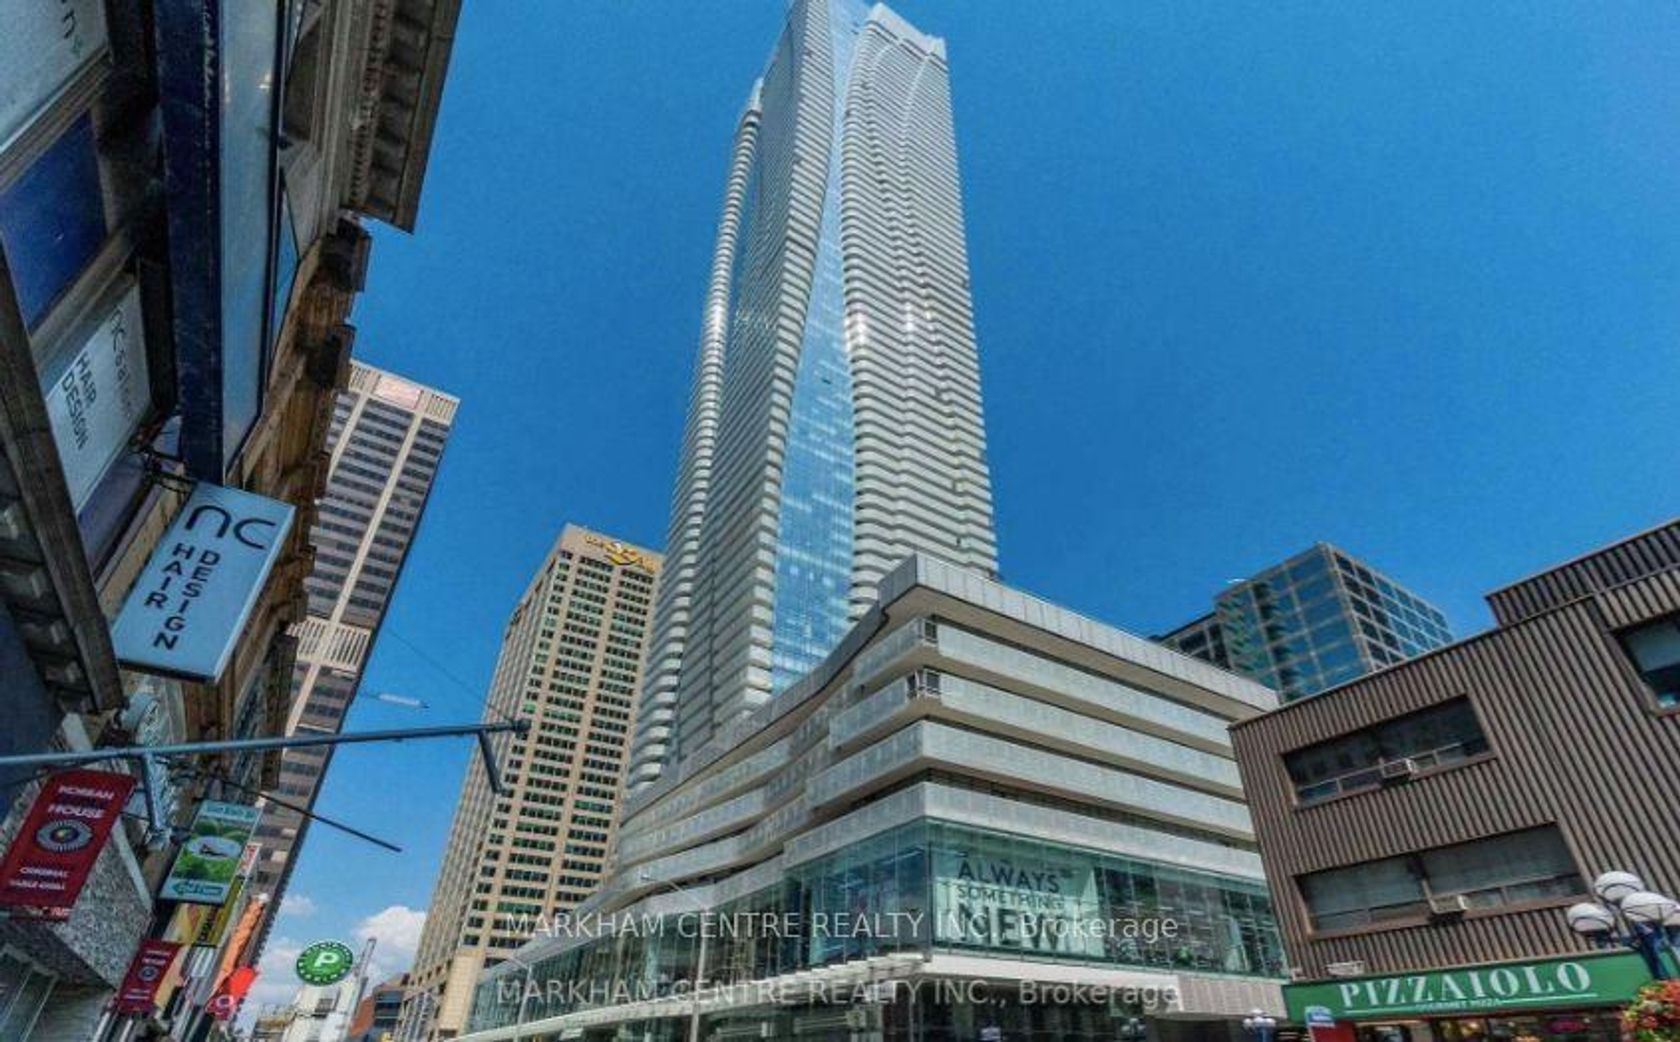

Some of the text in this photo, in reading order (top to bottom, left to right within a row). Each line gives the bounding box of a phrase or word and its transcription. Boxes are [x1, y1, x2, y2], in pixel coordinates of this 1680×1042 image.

[143, 542, 193, 611] HAIR
[153, 549, 220, 650] DESIGN
[47, 803, 105, 820] HOUSE
[957, 860, 1060, 894] ALWAYS
[1339, 962, 1592, 1008] PIZZAIOLO
